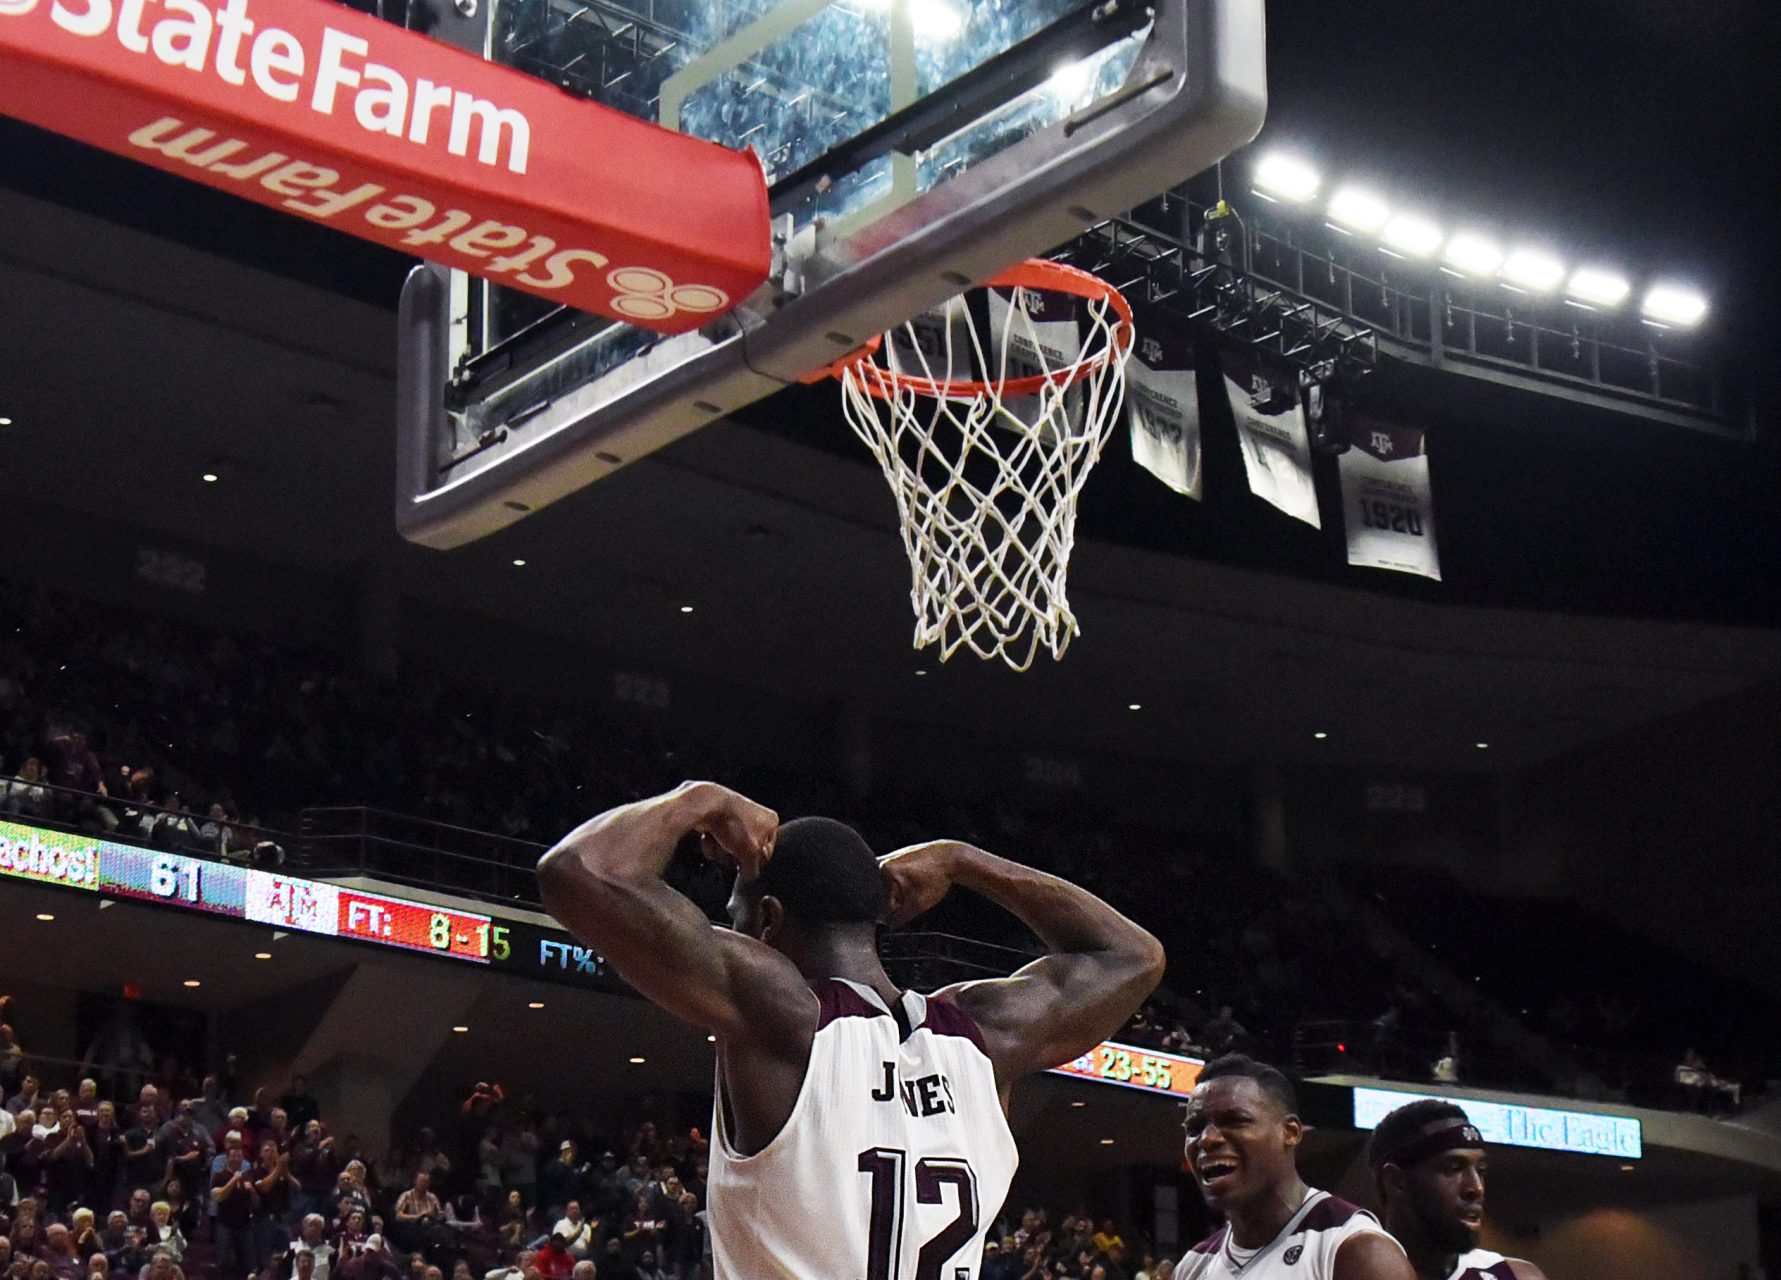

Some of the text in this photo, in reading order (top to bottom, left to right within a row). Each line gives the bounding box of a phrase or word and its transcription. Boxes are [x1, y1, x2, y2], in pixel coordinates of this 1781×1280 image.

[1361, 500, 1424, 537] 1920
[150, 852, 199, 902] 61
[350, 900, 391, 937] FT:
[1101, 1047, 1171, 1090] 23-55
[872, 1060, 957, 1118] JNES
[1501, 1107, 1553, 1143] The
